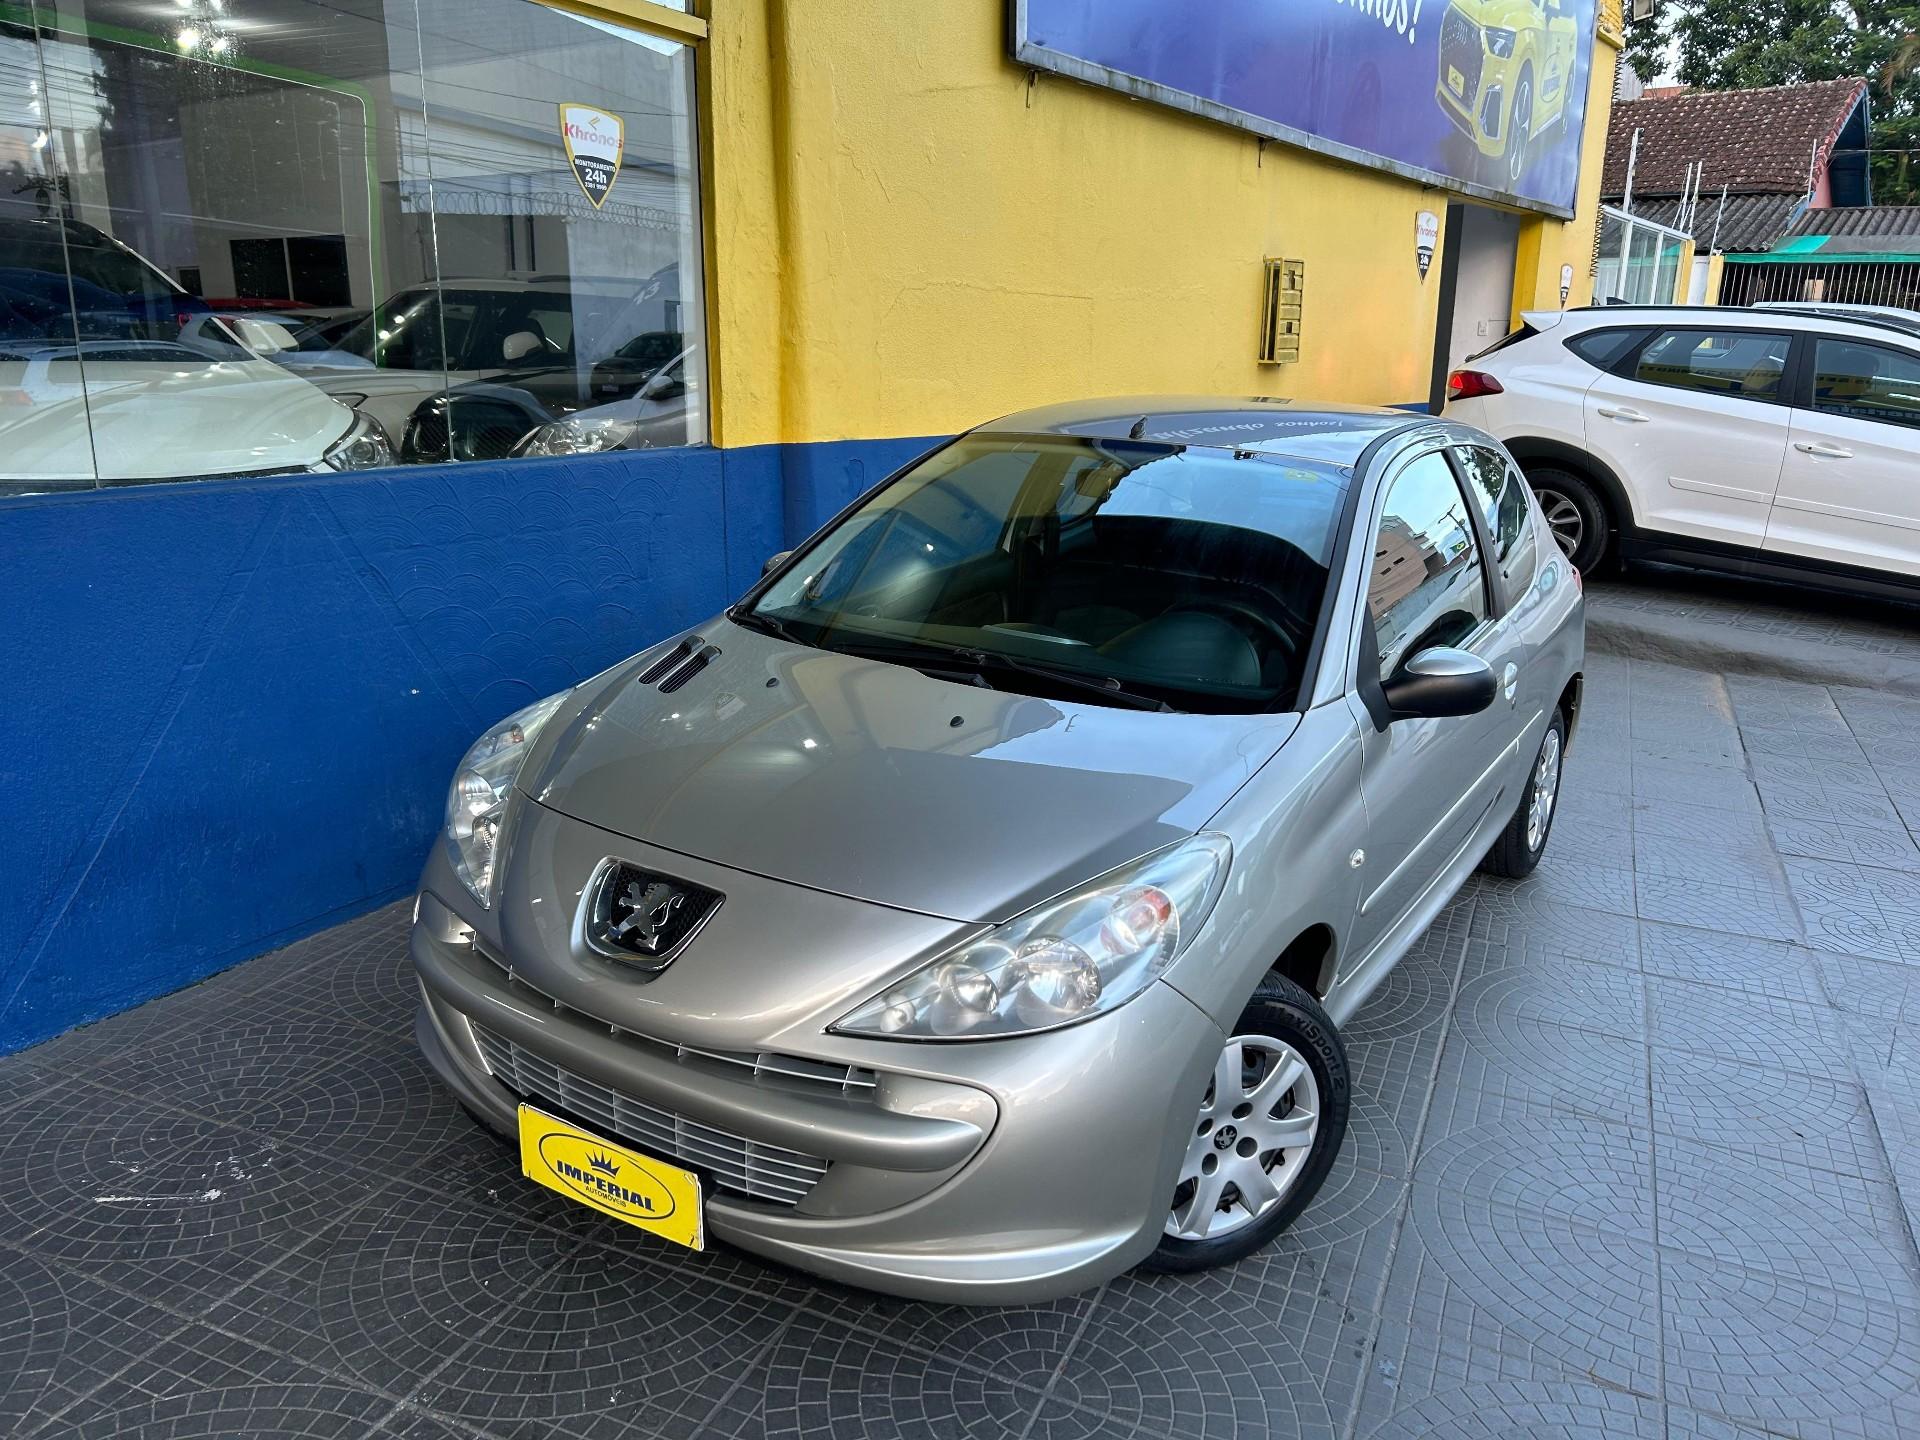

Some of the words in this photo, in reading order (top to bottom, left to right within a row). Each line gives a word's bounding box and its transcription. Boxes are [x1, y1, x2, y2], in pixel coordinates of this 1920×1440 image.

[564, 122, 623, 149] Khronos
[574, 158, 616, 173] MONITORAMENTO
[585, 168, 607, 184] 24h
[556, 1159, 656, 1213] IMPERIAL
